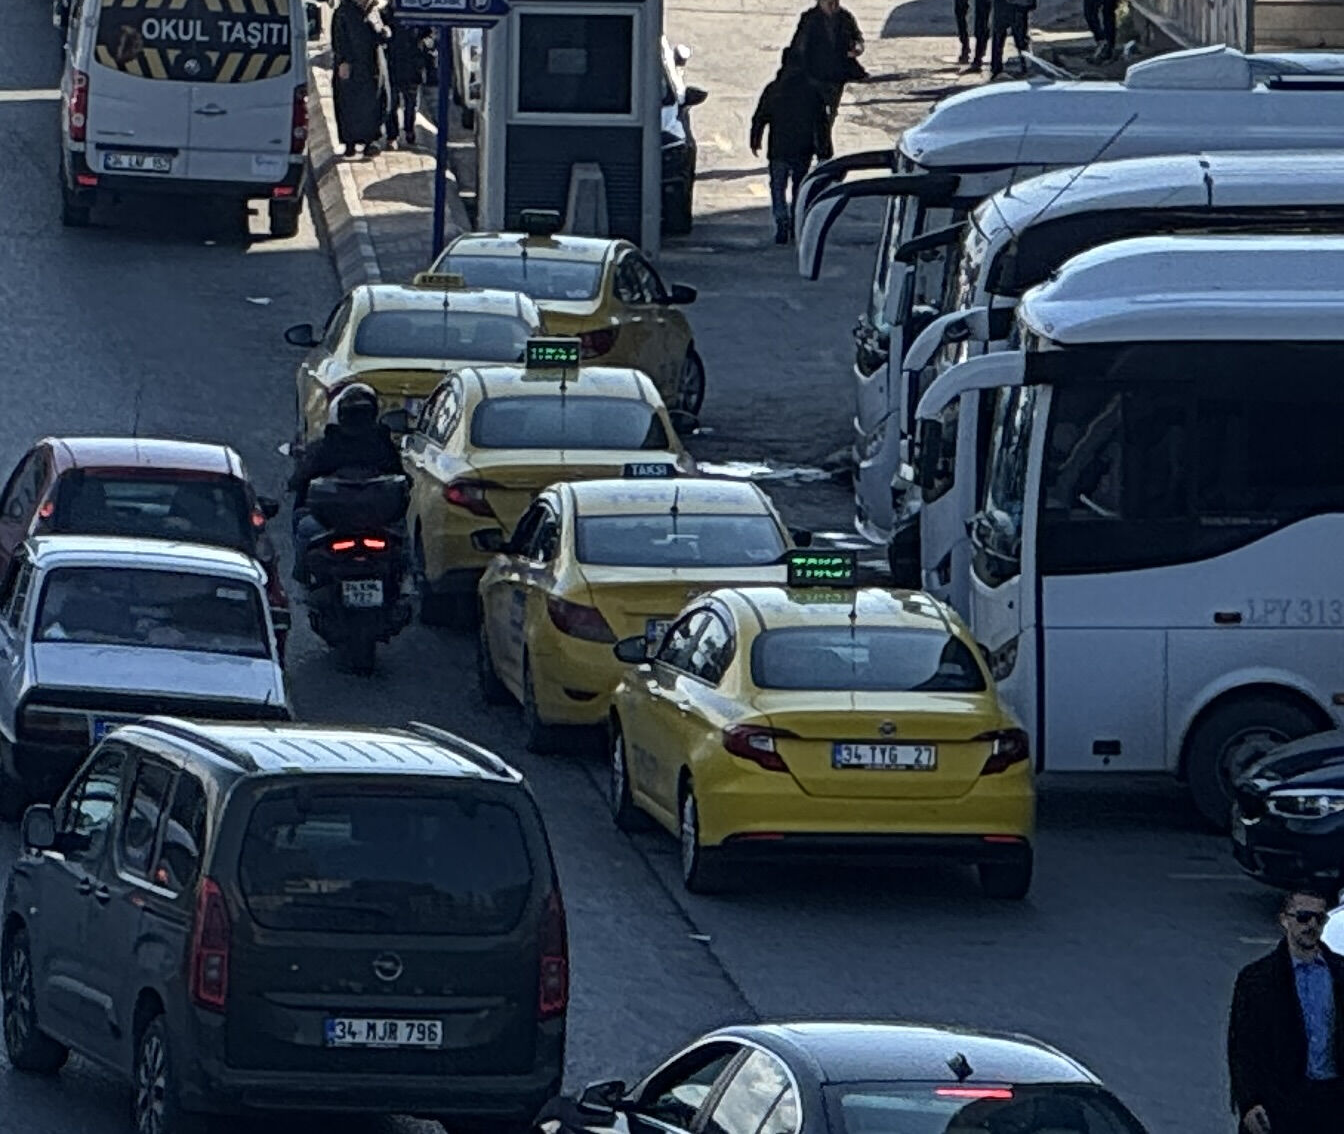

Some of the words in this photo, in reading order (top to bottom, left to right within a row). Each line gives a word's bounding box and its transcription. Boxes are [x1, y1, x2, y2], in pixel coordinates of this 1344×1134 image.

[142, 18, 209, 41] OKUL
[218, 21, 288, 48] TAŞITI
[843, 746, 861, 760] 34
[915, 748, 931, 763] 27
[334, 1022, 354, 1039] 34
[365, 1022, 396, 1041] MJR
[406, 1023, 438, 1042] 796
